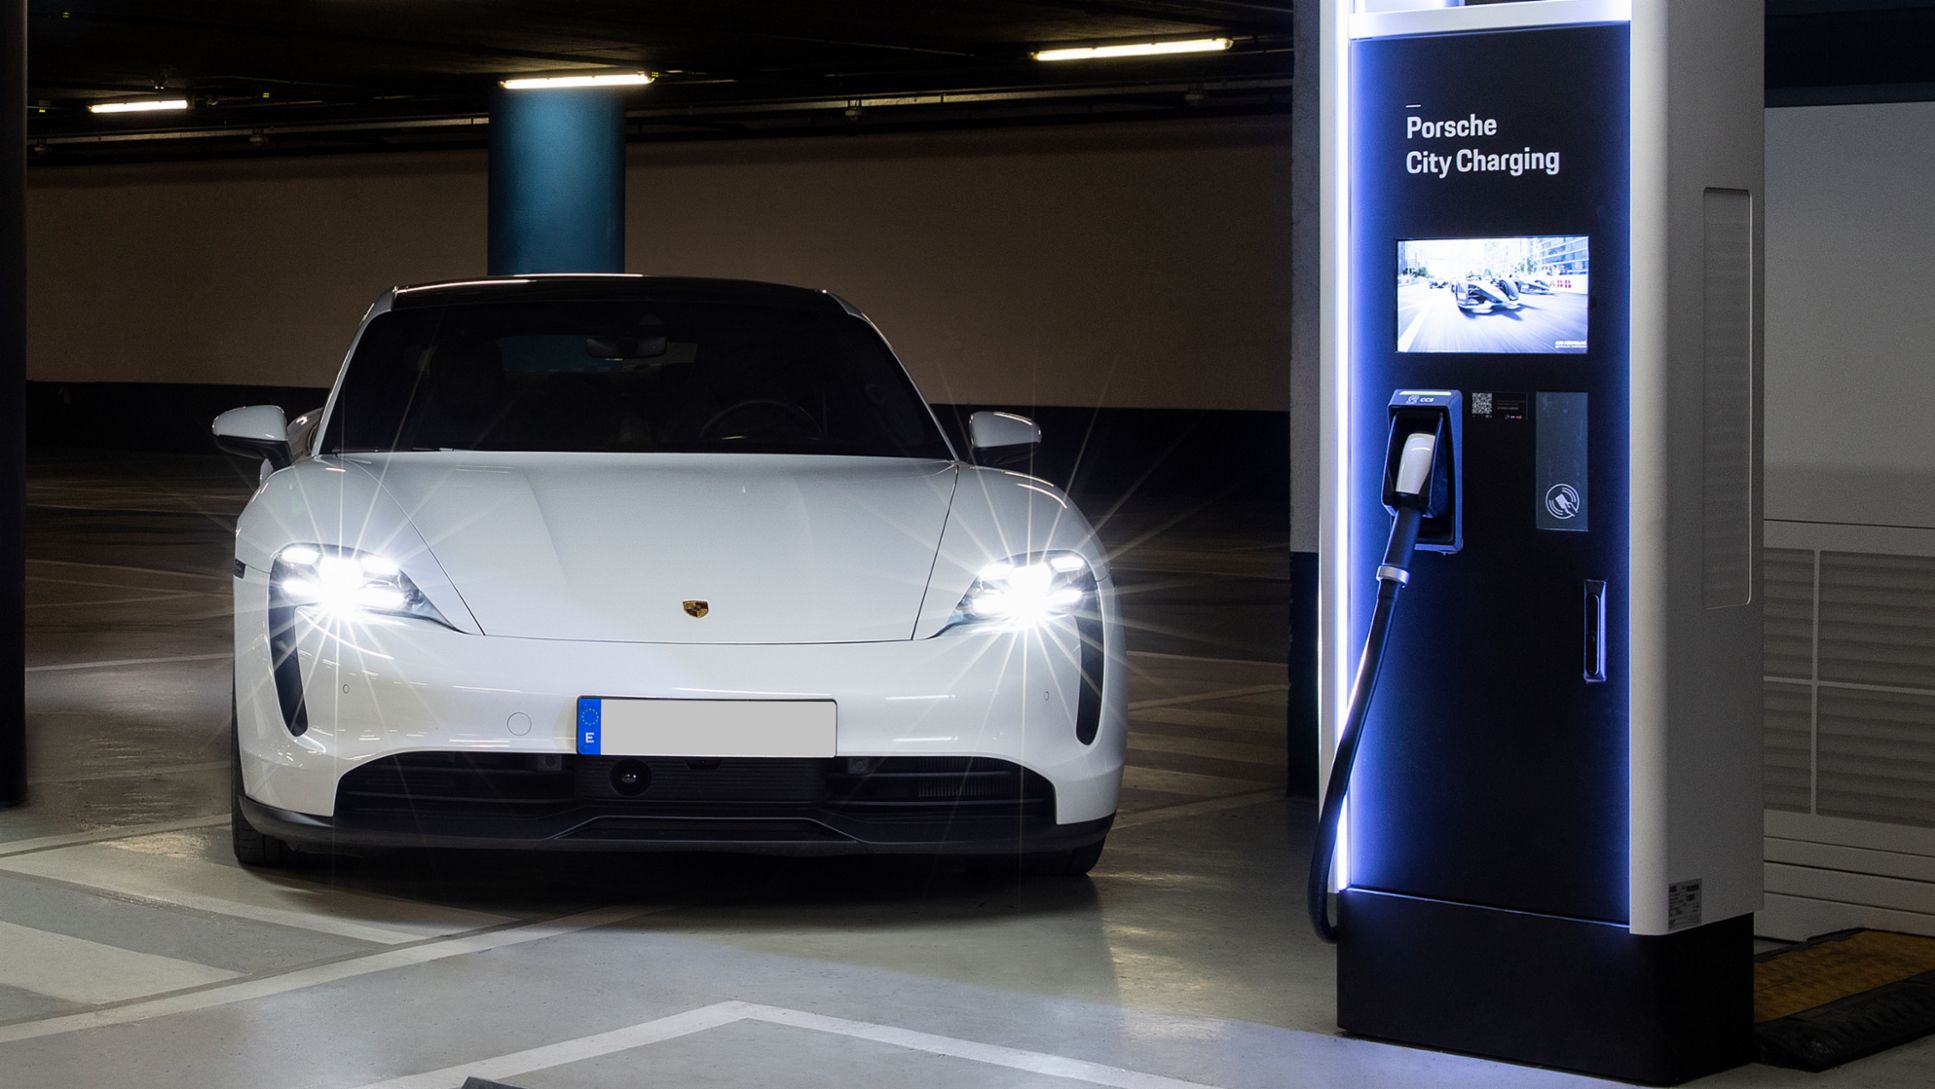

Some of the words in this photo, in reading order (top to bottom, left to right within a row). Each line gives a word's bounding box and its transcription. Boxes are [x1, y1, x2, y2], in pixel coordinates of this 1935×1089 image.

[1407, 114, 1498, 139] Porsche
[1406, 151, 1452, 179] City
[1456, 147, 1560, 176] Charging
[585, 732, 595, 744] E
